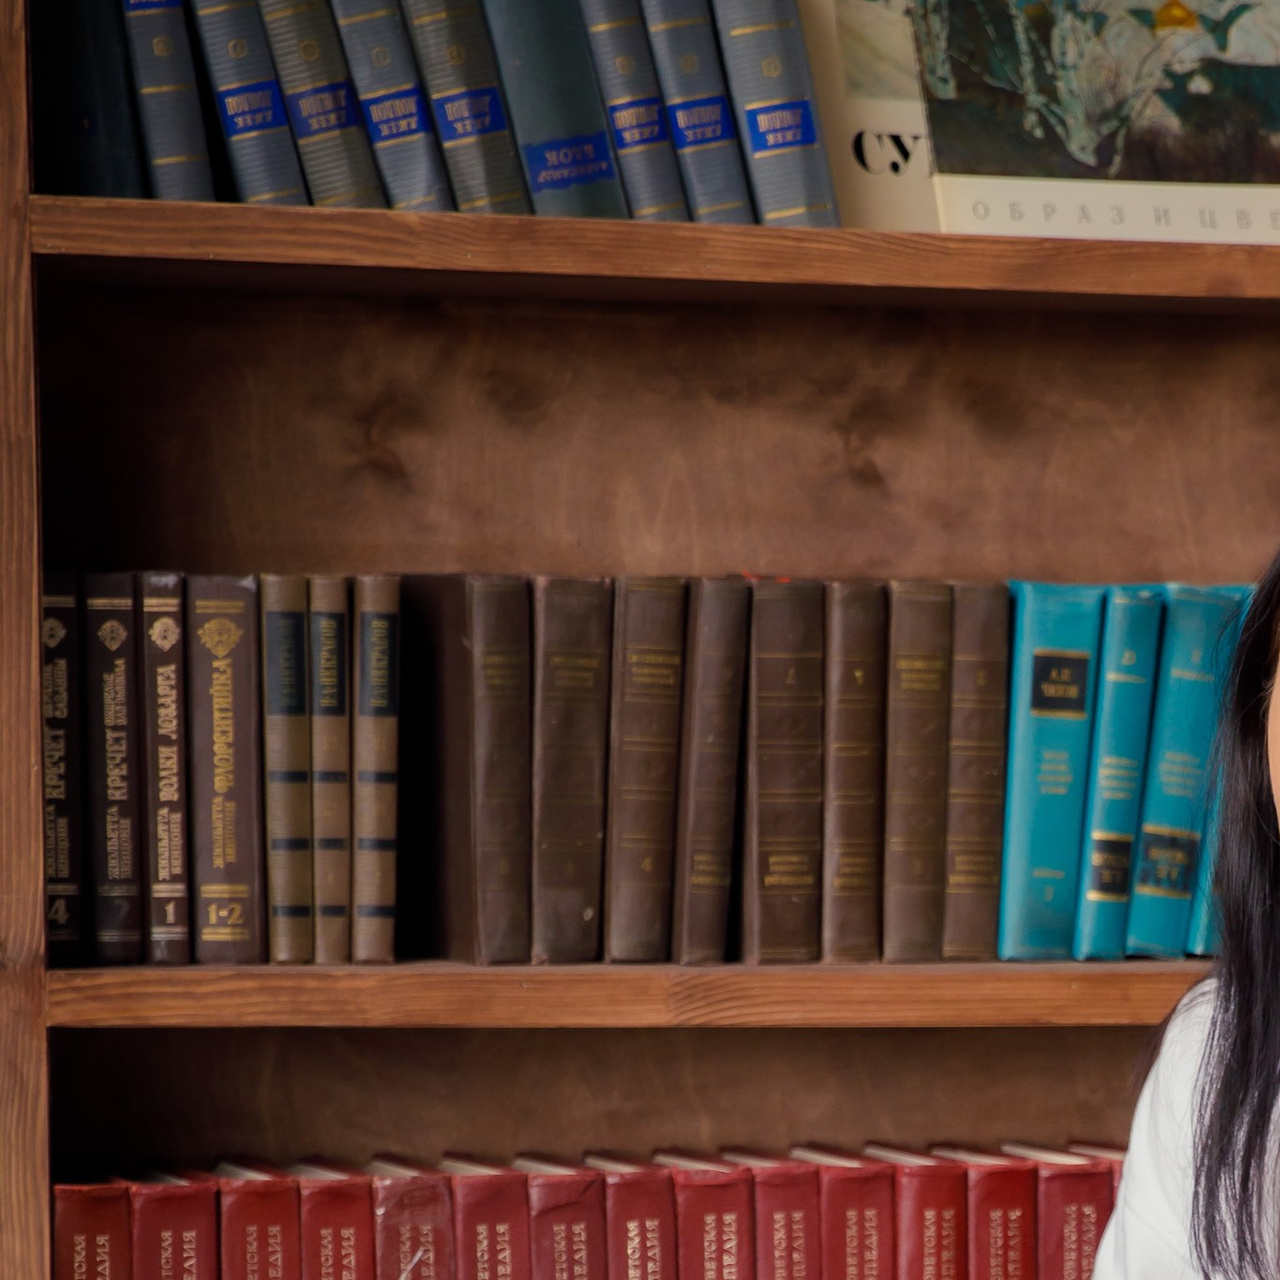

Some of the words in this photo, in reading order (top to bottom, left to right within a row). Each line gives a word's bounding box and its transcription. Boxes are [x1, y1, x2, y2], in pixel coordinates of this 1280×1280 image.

[971, 200, 1127, 227] ОБРАЗ
[1153, 206, 1173, 228] И
[156, 663, 178, 741] ЛОЗАРГА
[211, 658, 235, 794] ФЛОРЕНТИЙКА
[106, 728, 128, 801] КРЕЧЕТ
[159, 746, 180, 803] ВОЛКИ
[48, 898, 69, 925] 4
[164, 900, 176, 924] 1
[207, 903, 244, 925] 1-2
